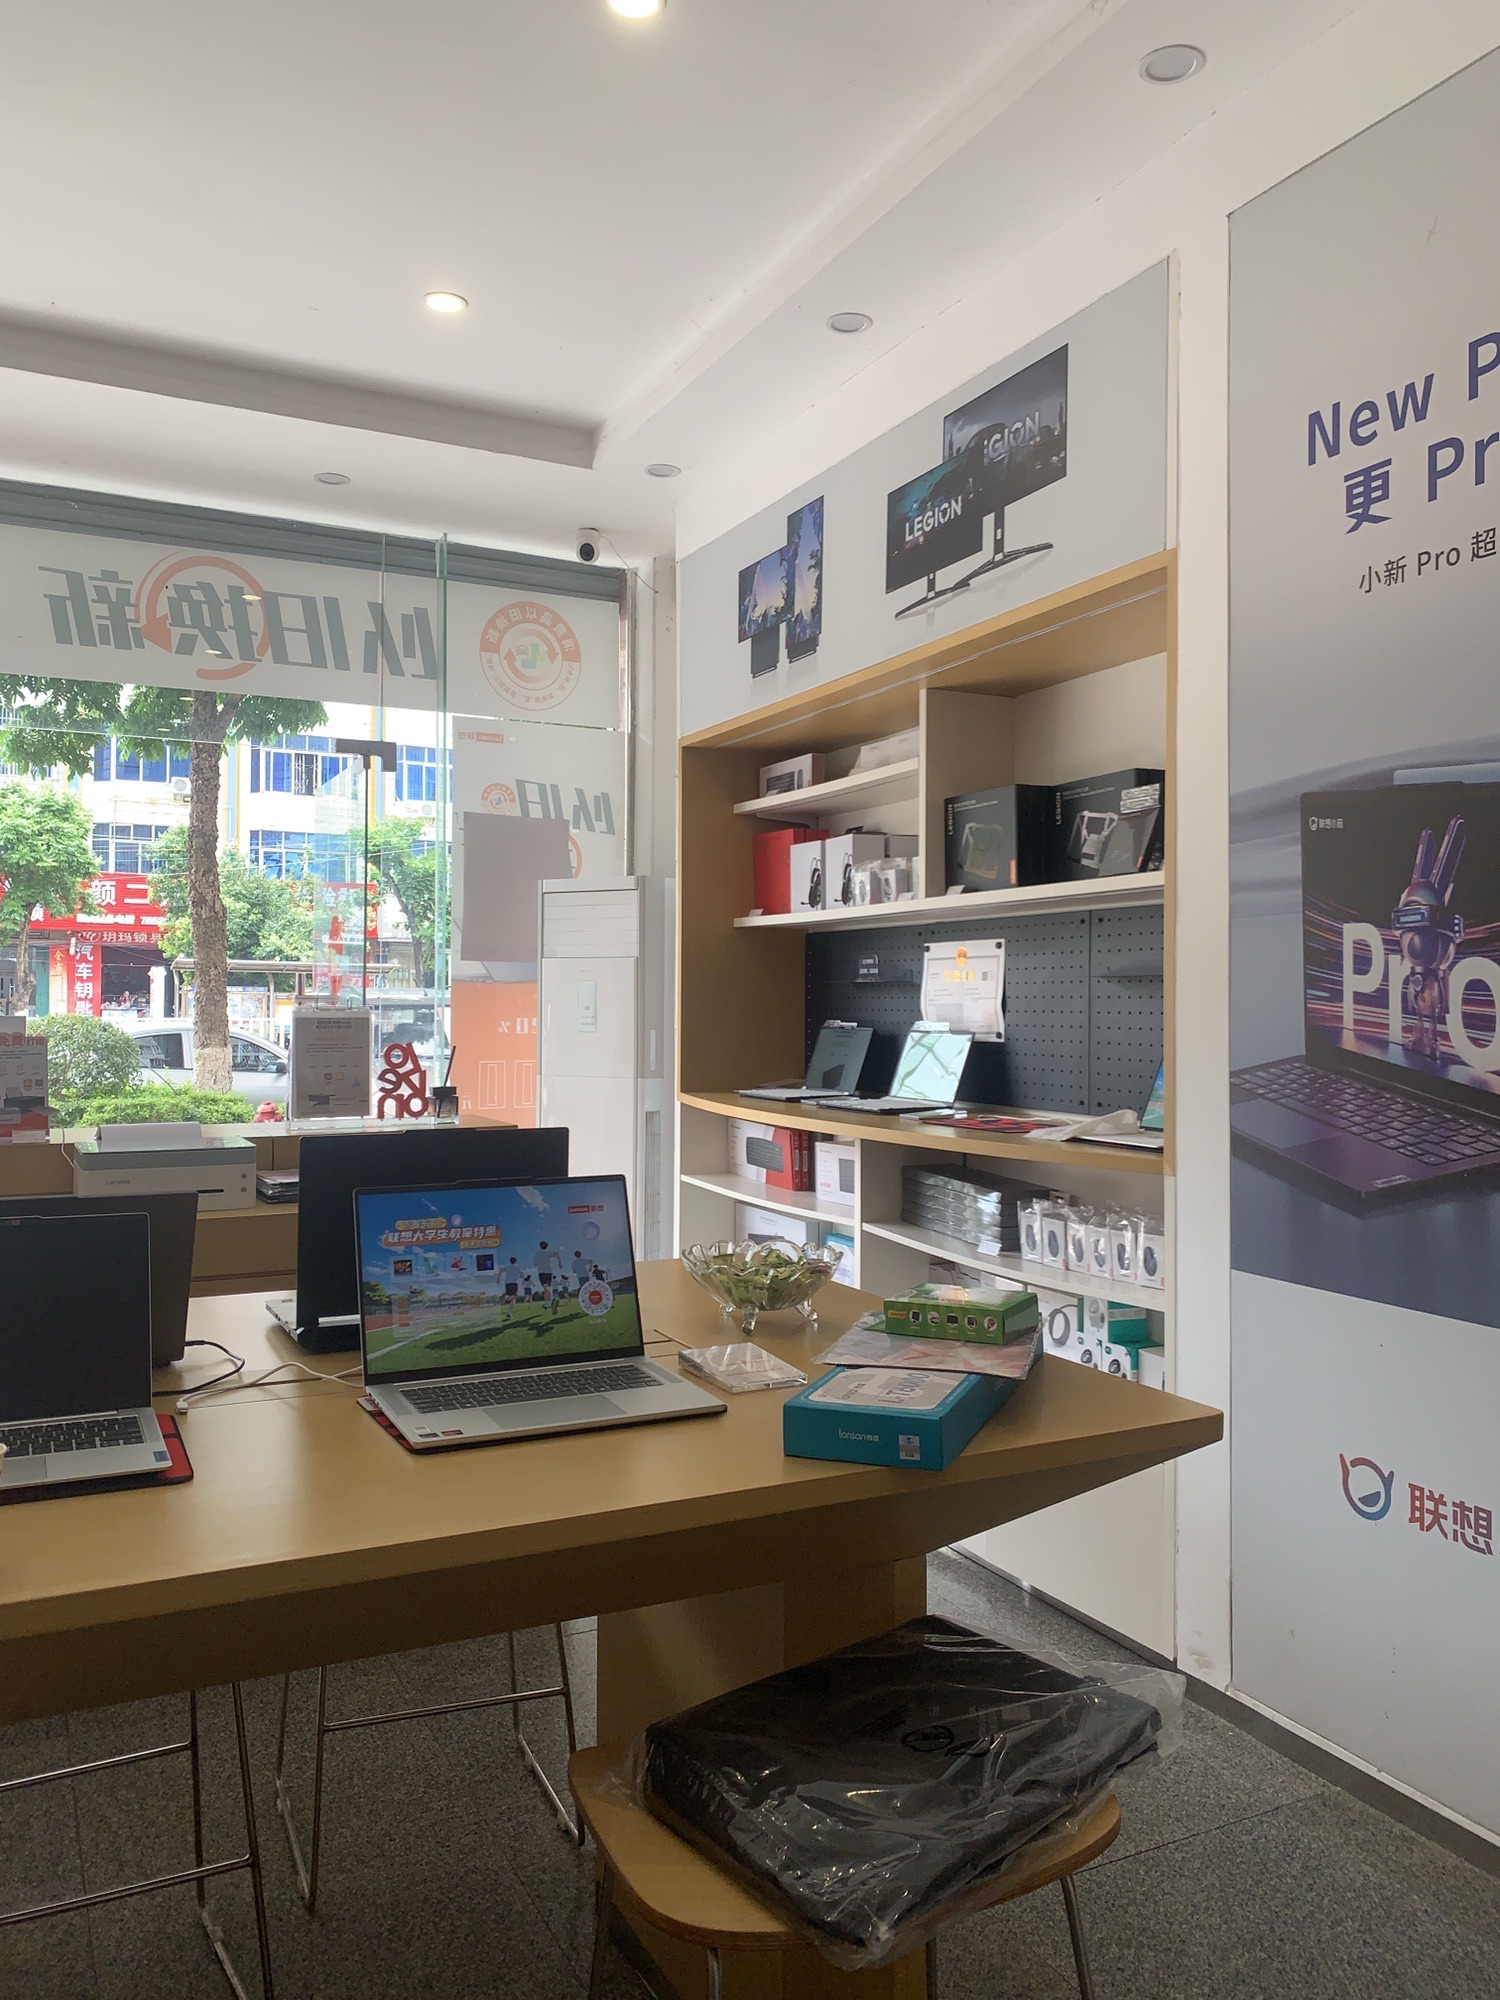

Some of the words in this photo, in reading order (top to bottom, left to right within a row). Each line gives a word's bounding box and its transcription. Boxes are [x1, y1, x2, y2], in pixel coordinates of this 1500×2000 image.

[1307, 373, 1435, 467] New
[905, 496, 963, 542] LEGION
[1344, 457, 1393, 534] 更
[1359, 556, 1407, 594] 小新
[1418, 545, 1461, 576] Pro
[1470, 527, 1497, 563] 超
[74, 944, 94, 1016] 汽车钥匙
[1342, 922, 1500, 1072] Pro
[105, 1178, 131, 1187] Lenovo
[1408, 1482, 1494, 1556] 联想
